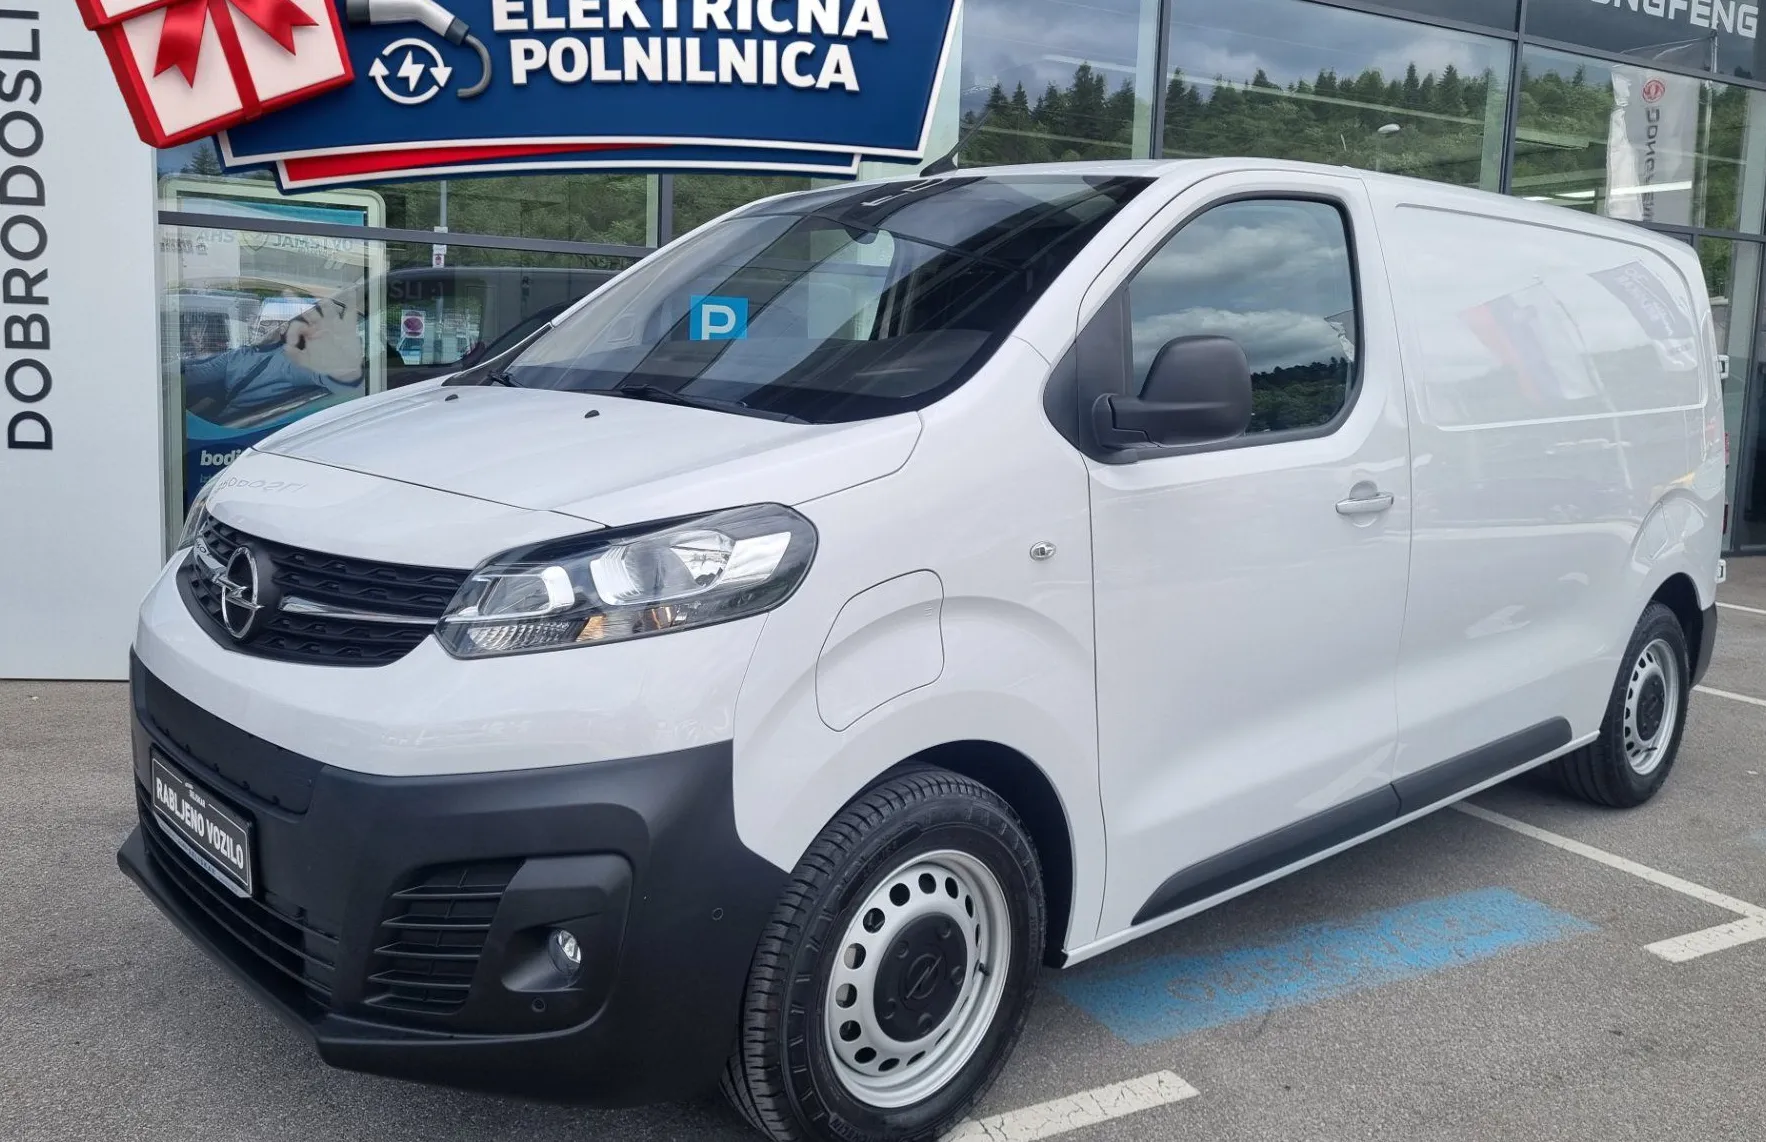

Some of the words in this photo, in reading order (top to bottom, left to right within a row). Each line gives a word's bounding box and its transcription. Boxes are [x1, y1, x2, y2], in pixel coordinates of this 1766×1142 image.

[1591, 0, 1758, 38] GFENG
[701, 303, 736, 340] P
[156, 776, 204, 837] RABLJENO
[206, 817, 244, 870] VOZILO
